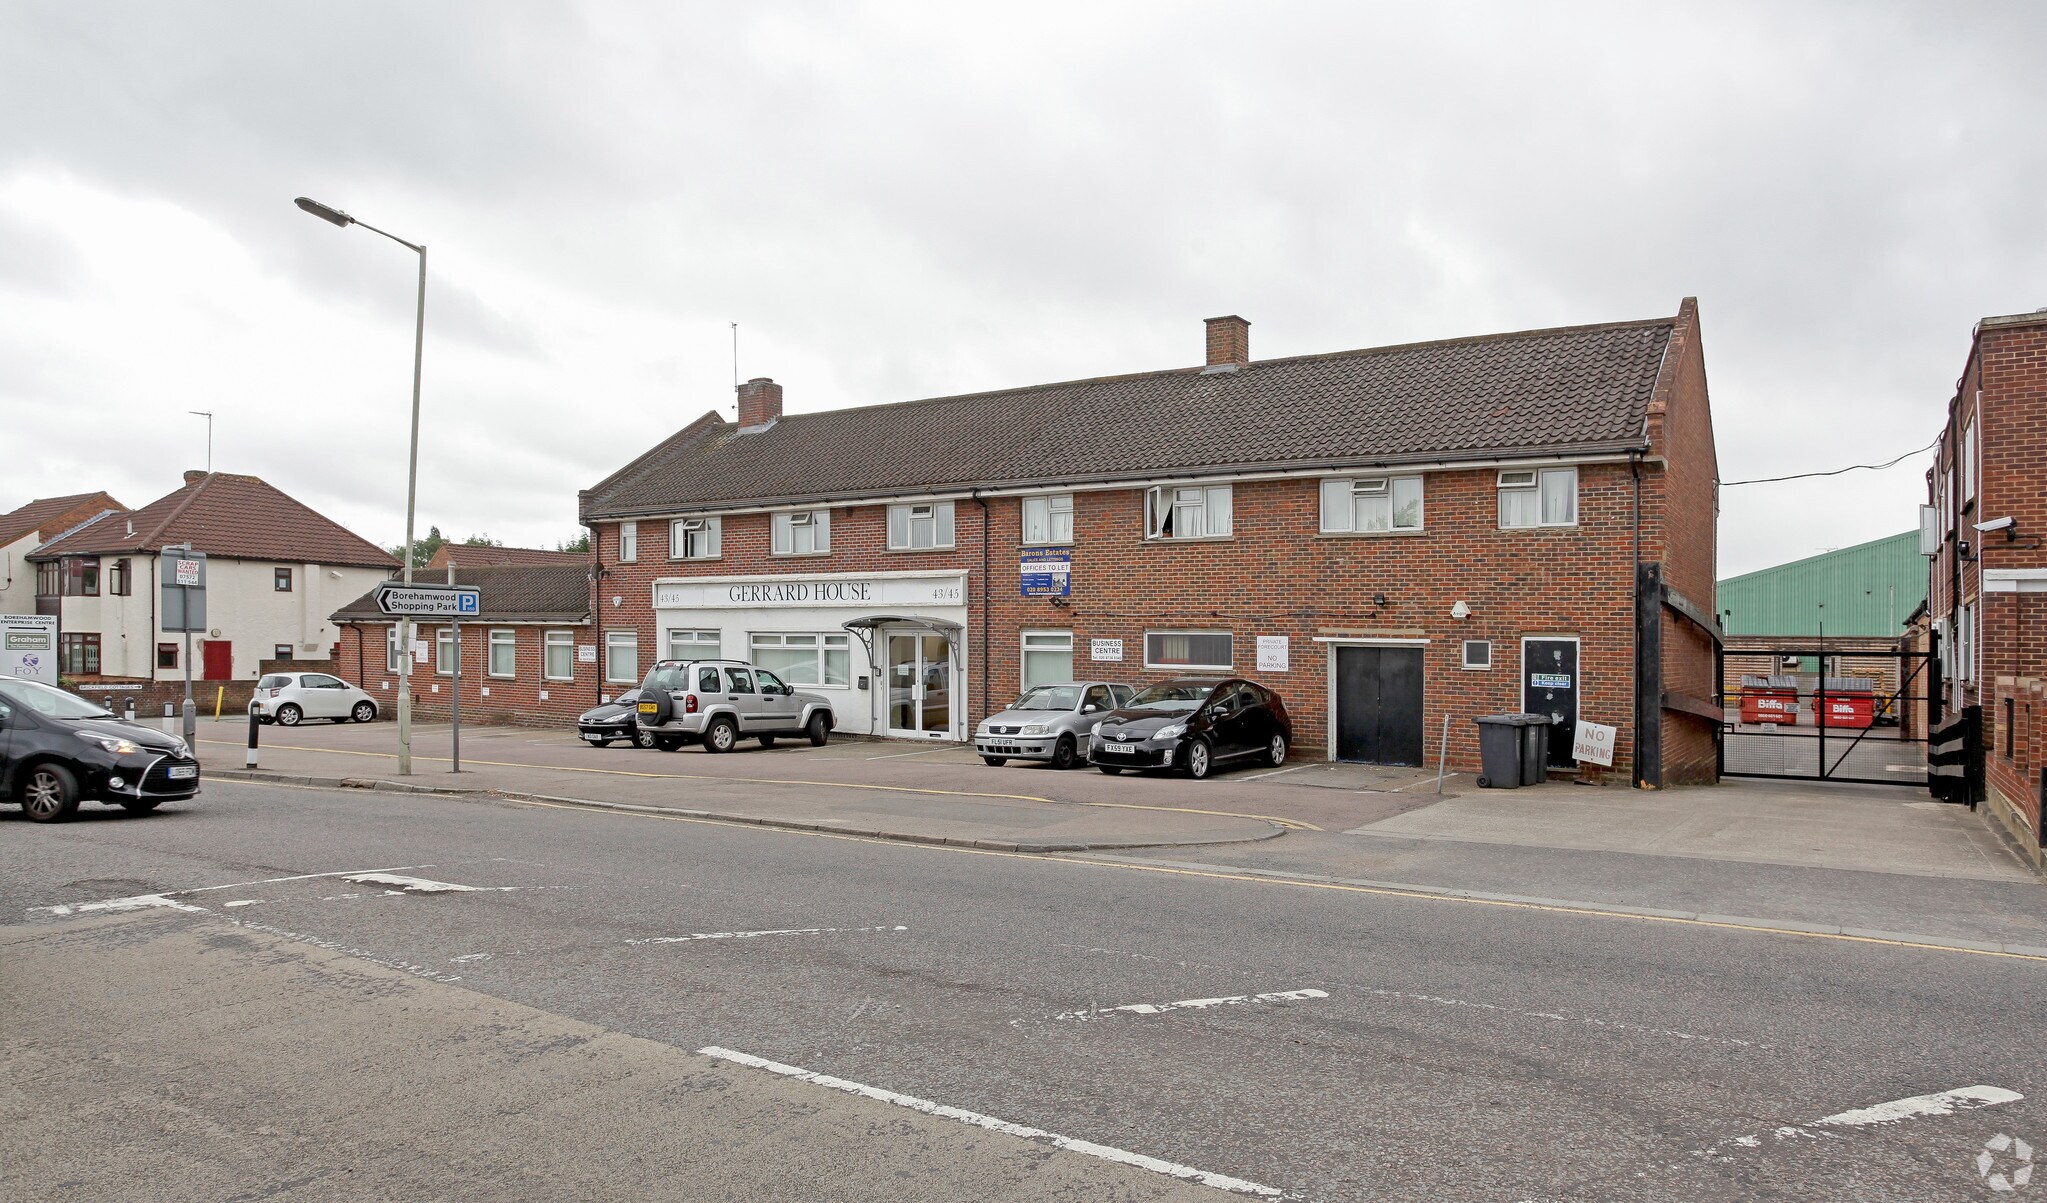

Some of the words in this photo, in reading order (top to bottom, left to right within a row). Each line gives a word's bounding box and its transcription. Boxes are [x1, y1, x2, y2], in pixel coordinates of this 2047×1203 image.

[392, 592, 456, 600] Borehamwood
[660, 593, 680, 602] 43/45
[729, 584, 808, 602] GERRARD
[814, 582, 870, 600] HOUSE
[932, 587, 960, 599] 43/45
[392, 602, 434, 612] Shopping
[436, 602, 457, 610] Park
[1758, 699, 1782, 710] Biffa
[1832, 704, 1854, 713] Biffa
[1585, 728, 1605, 742] NO
[1575, 742, 1610, 760] PARKING
